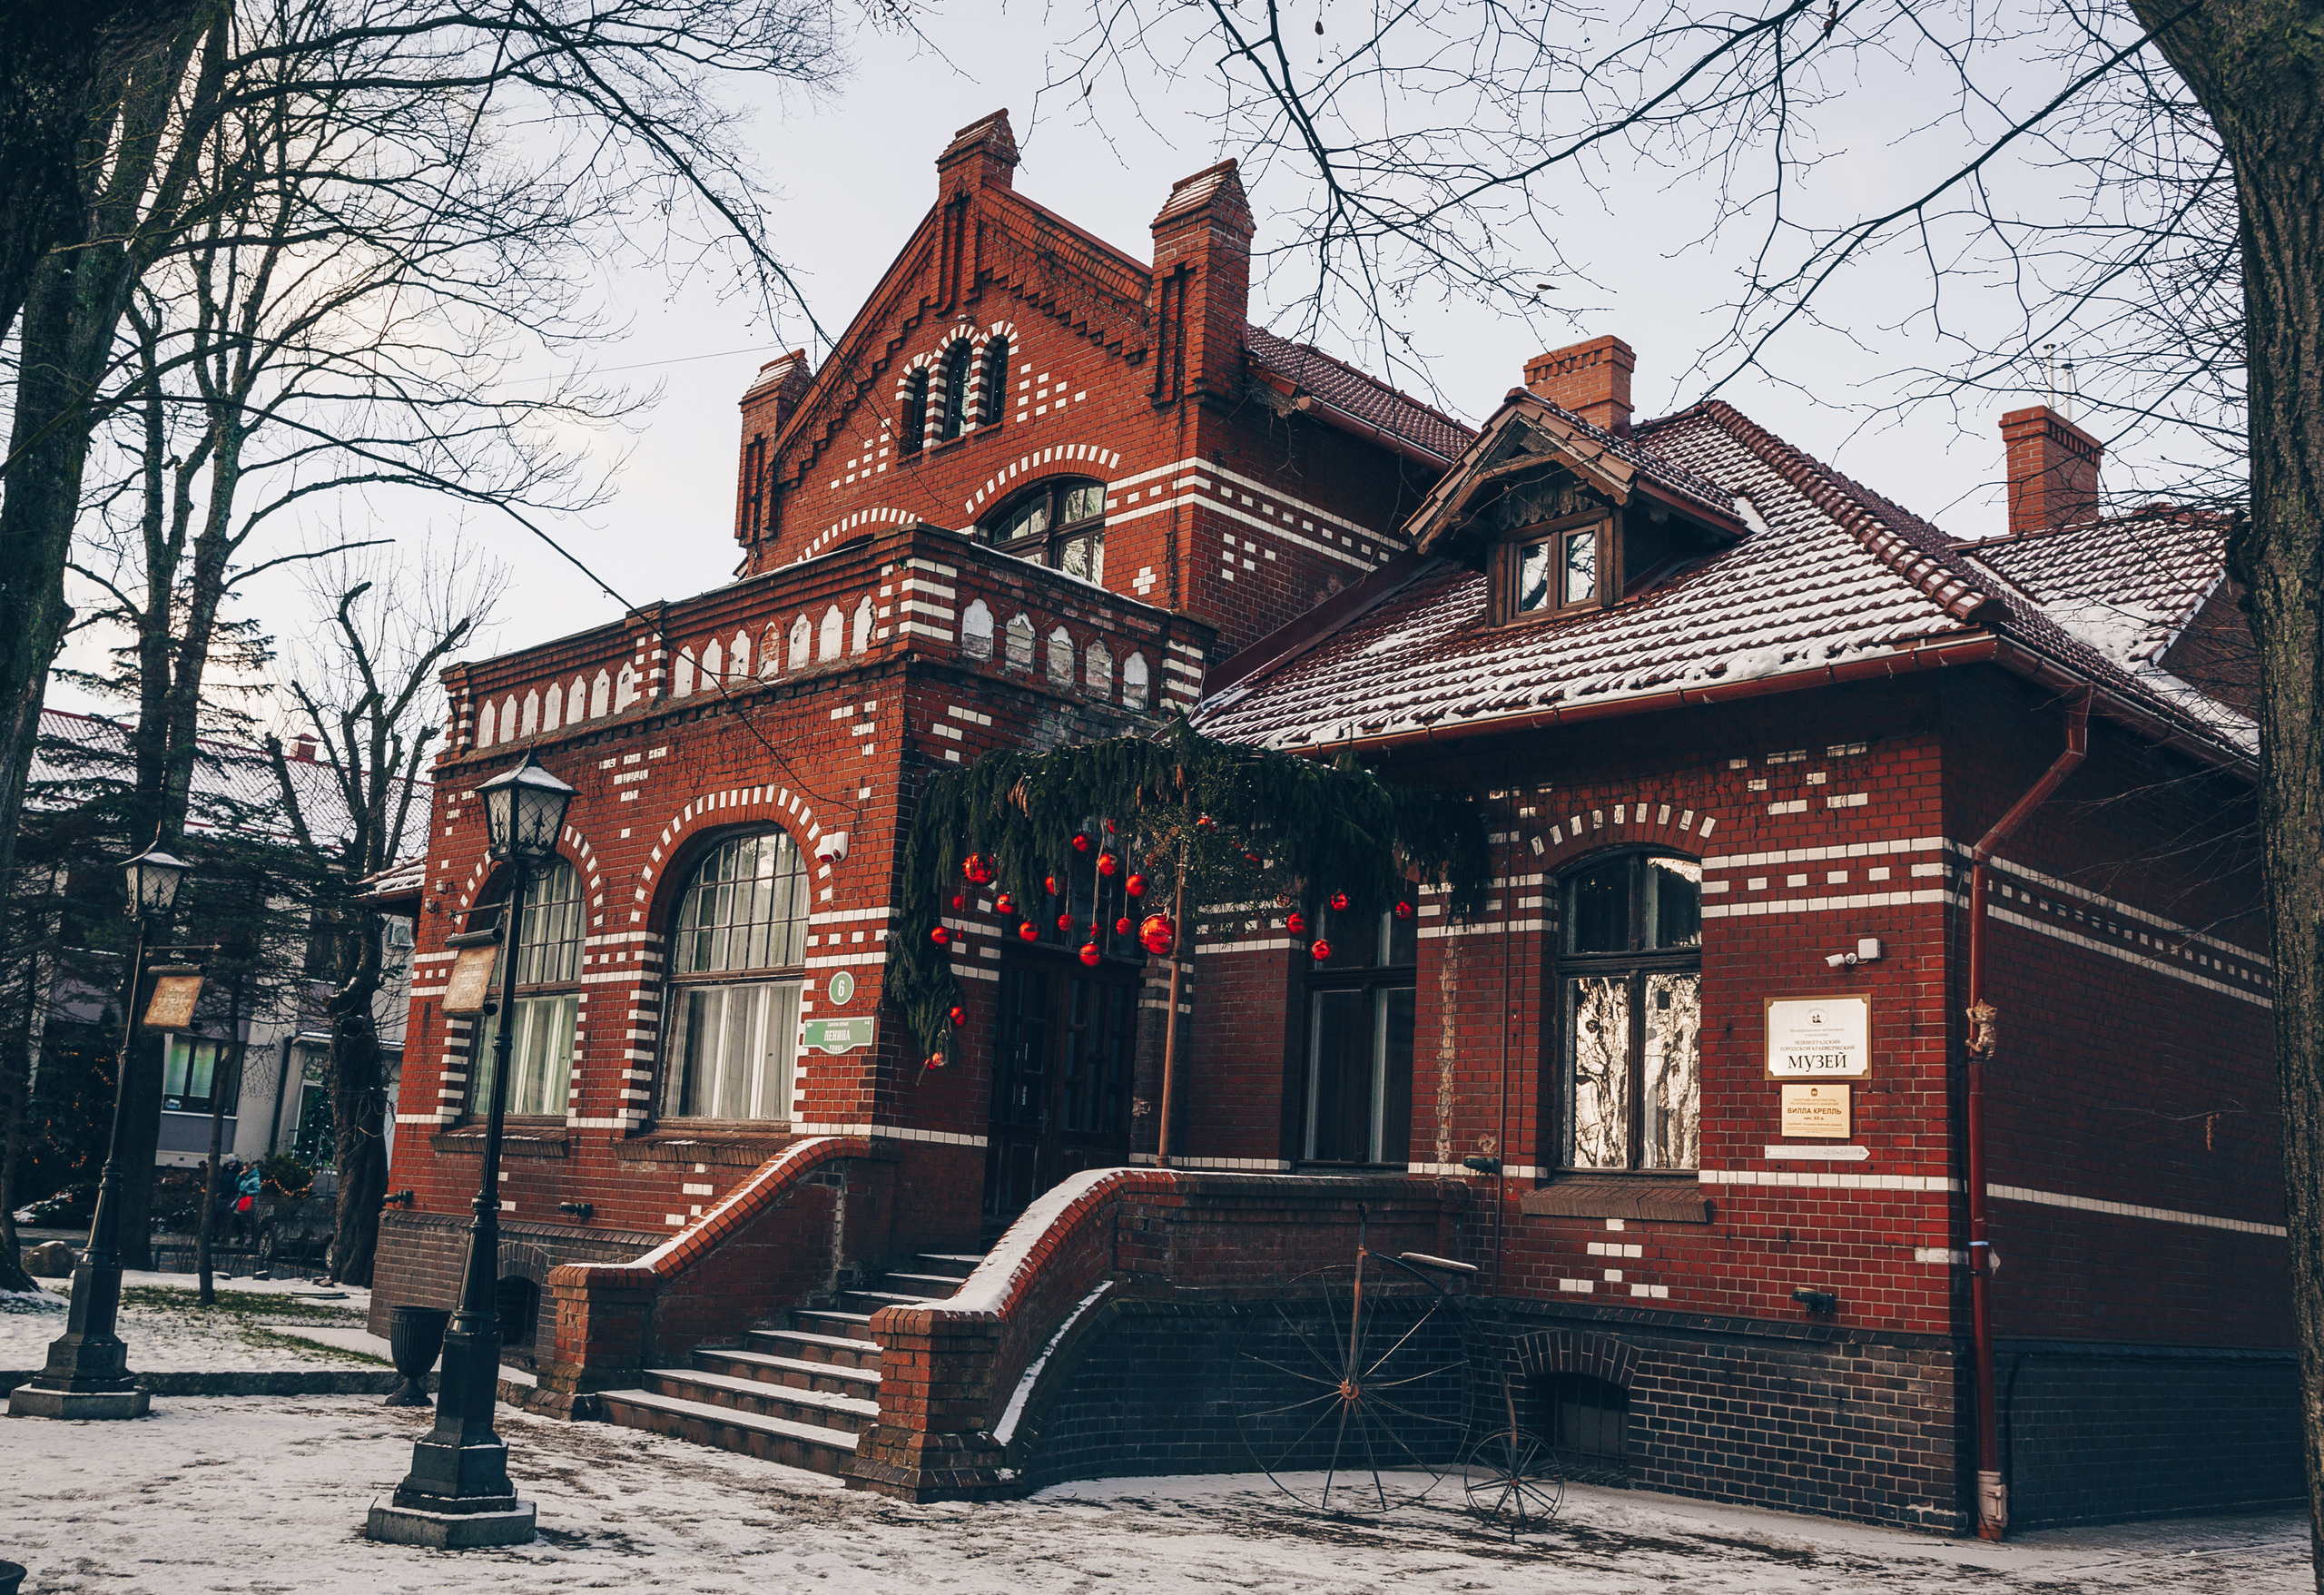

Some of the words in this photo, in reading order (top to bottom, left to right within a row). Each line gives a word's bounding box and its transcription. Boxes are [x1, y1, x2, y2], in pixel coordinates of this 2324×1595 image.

[838, 980, 845, 997] 6
[823, 1029, 851, 1041] ЛЕНИНА
[1788, 1051, 1847, 1072] МУЗЕЙ
